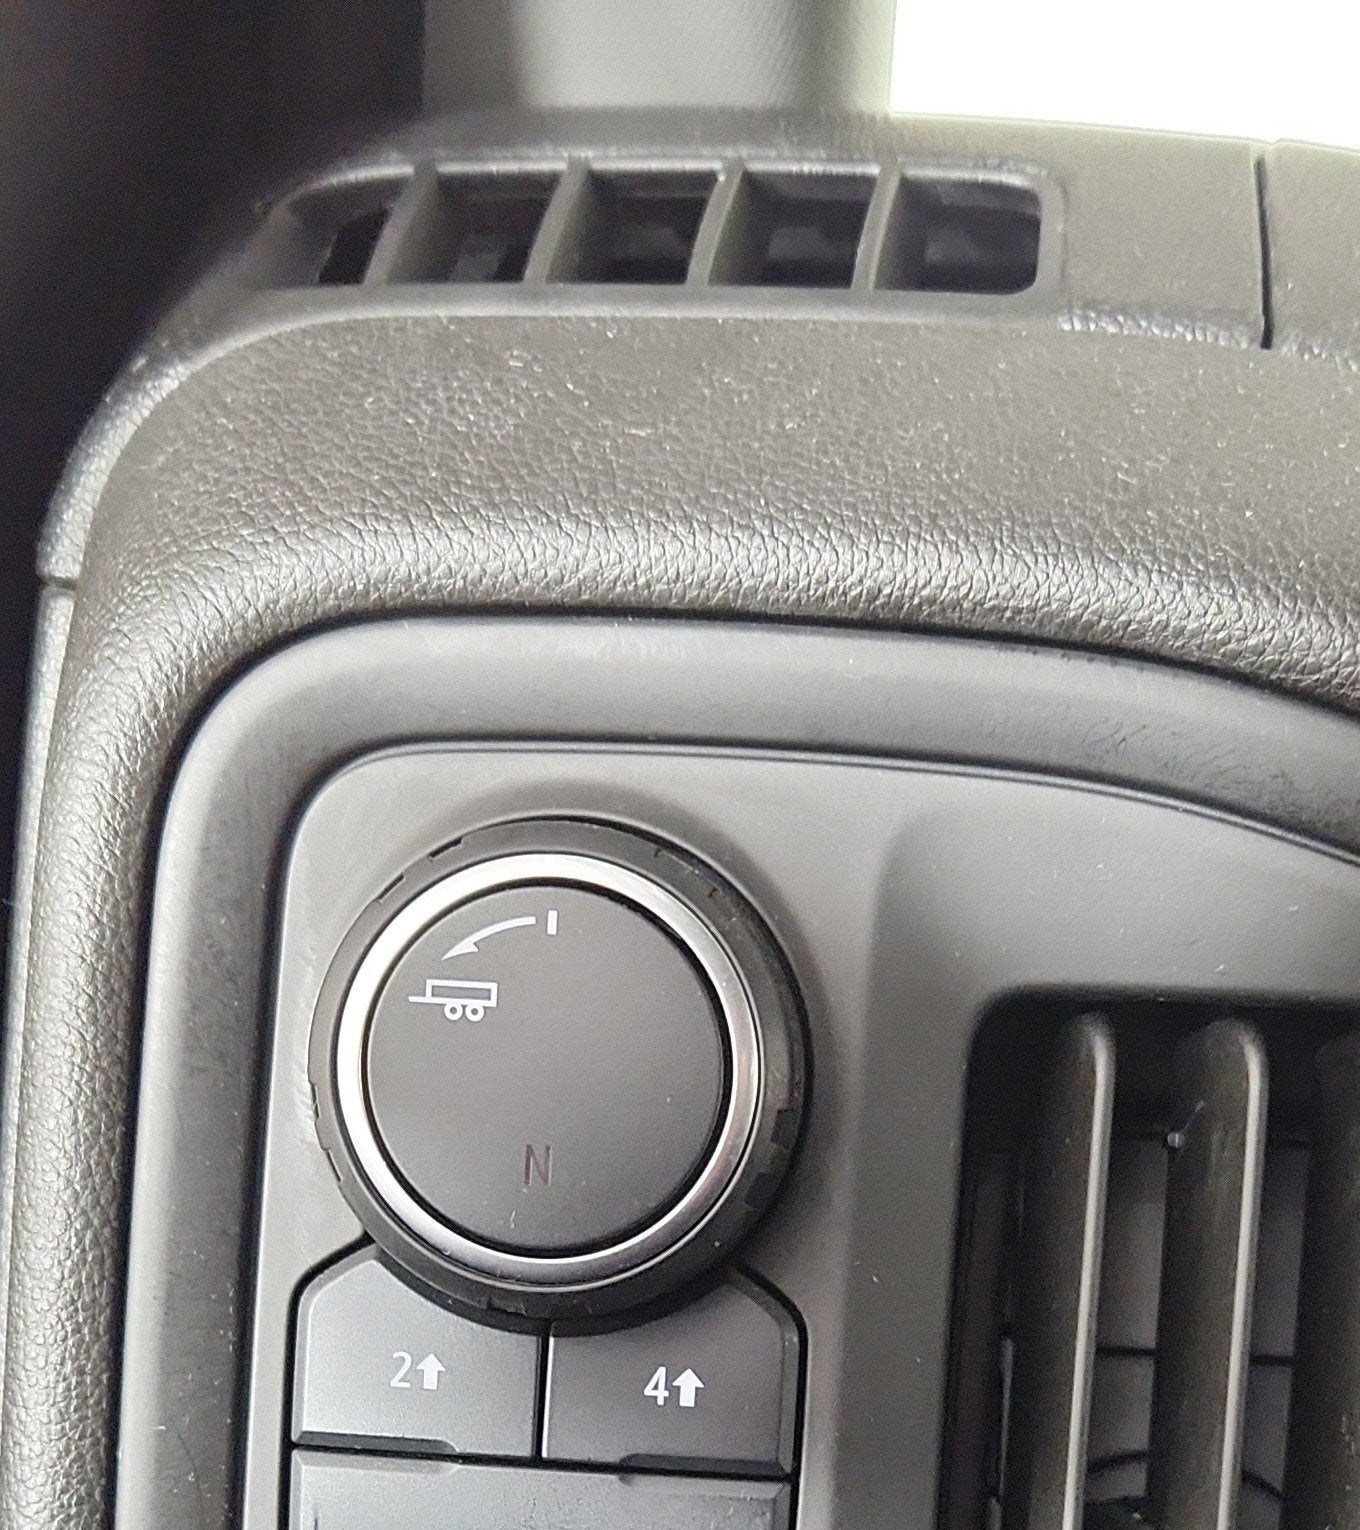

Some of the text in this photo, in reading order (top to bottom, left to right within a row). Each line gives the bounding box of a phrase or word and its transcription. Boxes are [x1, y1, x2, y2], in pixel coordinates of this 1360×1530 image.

[524, 1144, 552, 1187] N
[390, 1352, 415, 1389] 2
[644, 1366, 670, 1406] 4
